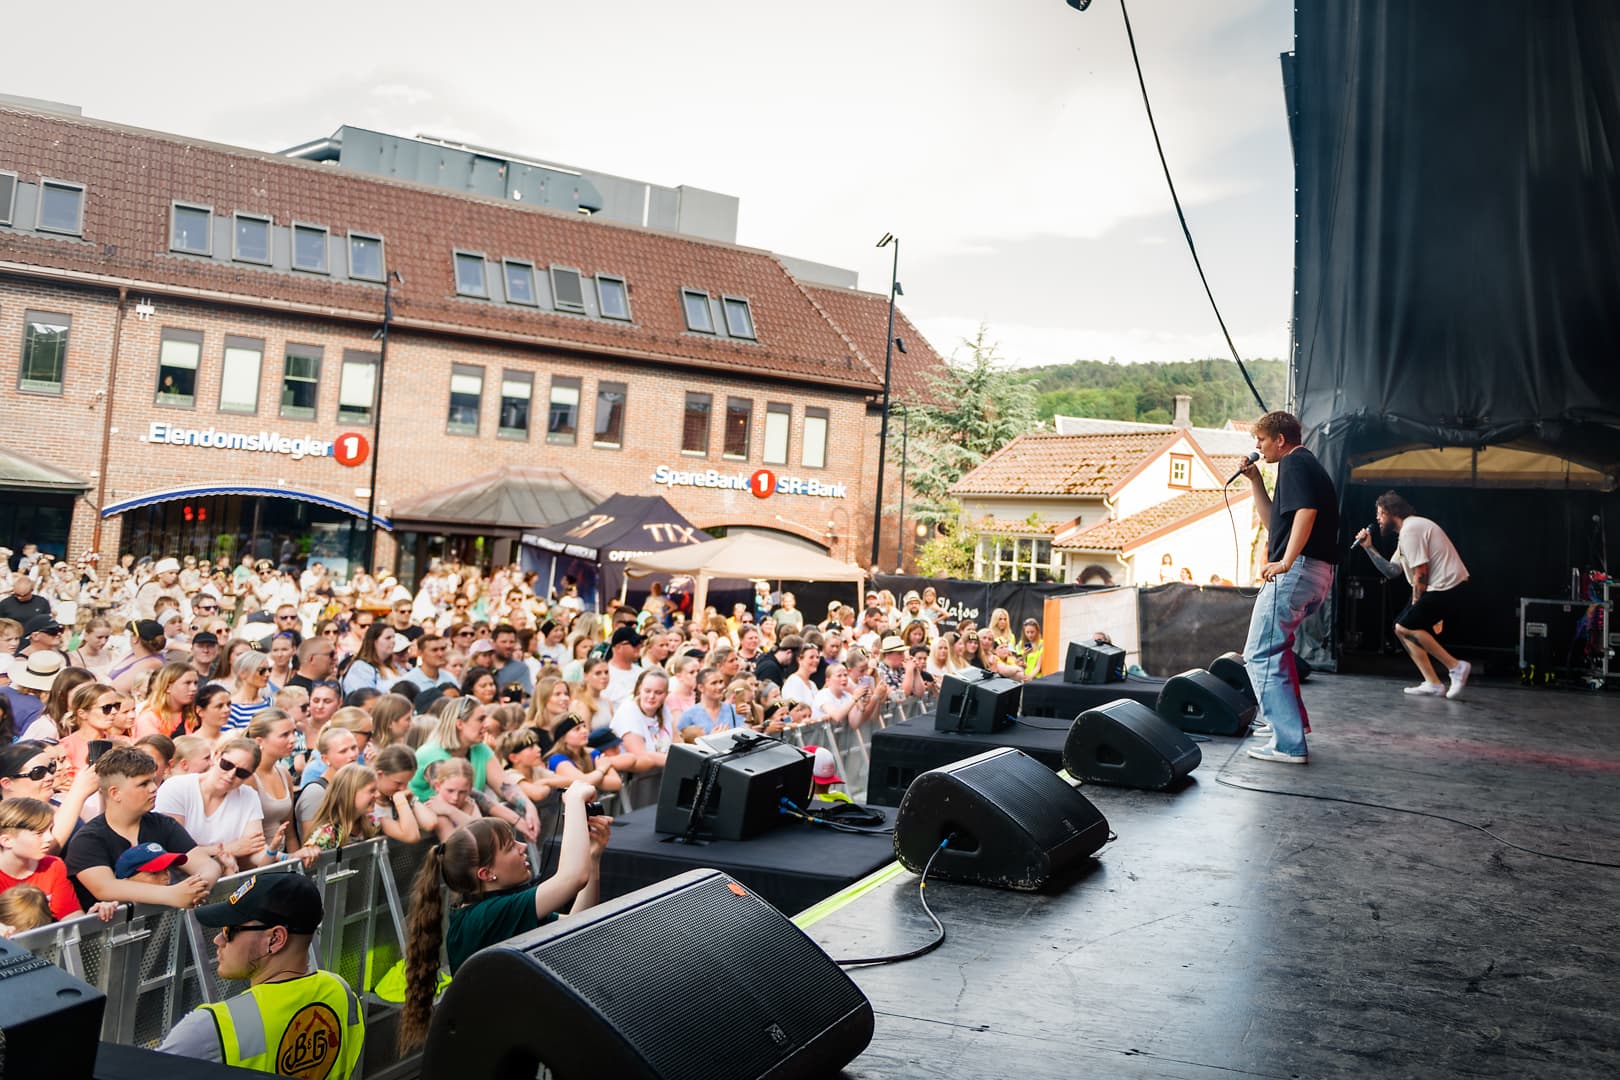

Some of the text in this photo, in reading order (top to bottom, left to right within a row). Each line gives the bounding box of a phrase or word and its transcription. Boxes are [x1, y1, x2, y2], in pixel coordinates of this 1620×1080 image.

[149, 422, 359, 460] EiendomsMegler 1
[655, 465, 847, 498] SpareBank 1 SR-Bank
[642, 523, 701, 544] TIX
